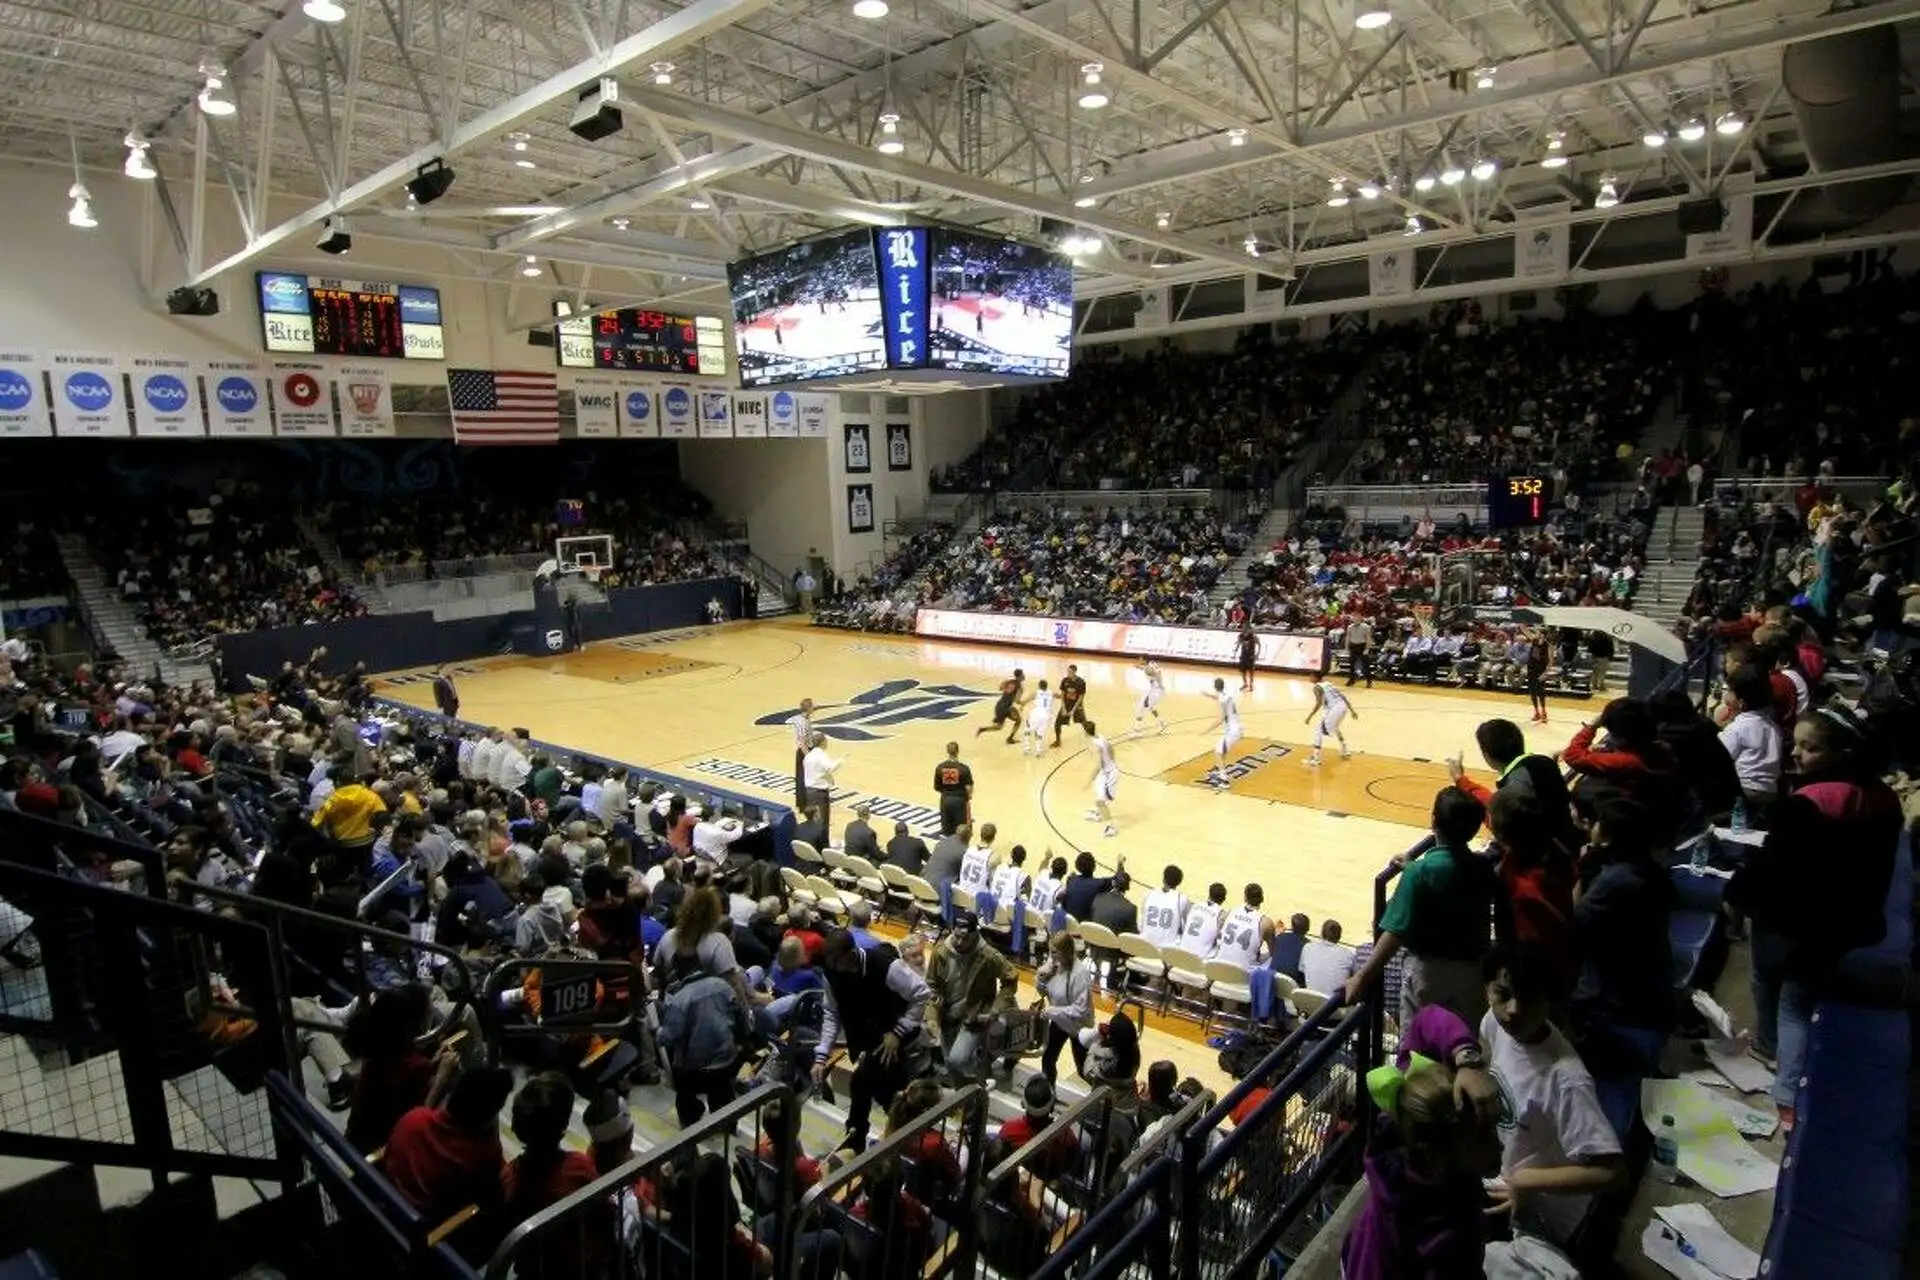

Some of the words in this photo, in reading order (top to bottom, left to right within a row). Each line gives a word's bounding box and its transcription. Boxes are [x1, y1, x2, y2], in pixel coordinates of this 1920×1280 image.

[888, 231, 918, 364] Rice
[268, 320, 312, 342] Rice
[404, 334, 443, 349] Owls
[0, 384, 29, 396] CAA
[68, 385, 110, 397] NCAA
[146, 387, 185, 399] NCAA
[217, 389, 256, 400] NCAA
[1509, 480, 1542, 495] 3:52
[1532, 496, 1539, 518] 1
[1146, 905, 1174, 930] 20
[1223, 922, 1253, 951] 54
[554, 981, 590, 1014] 109
